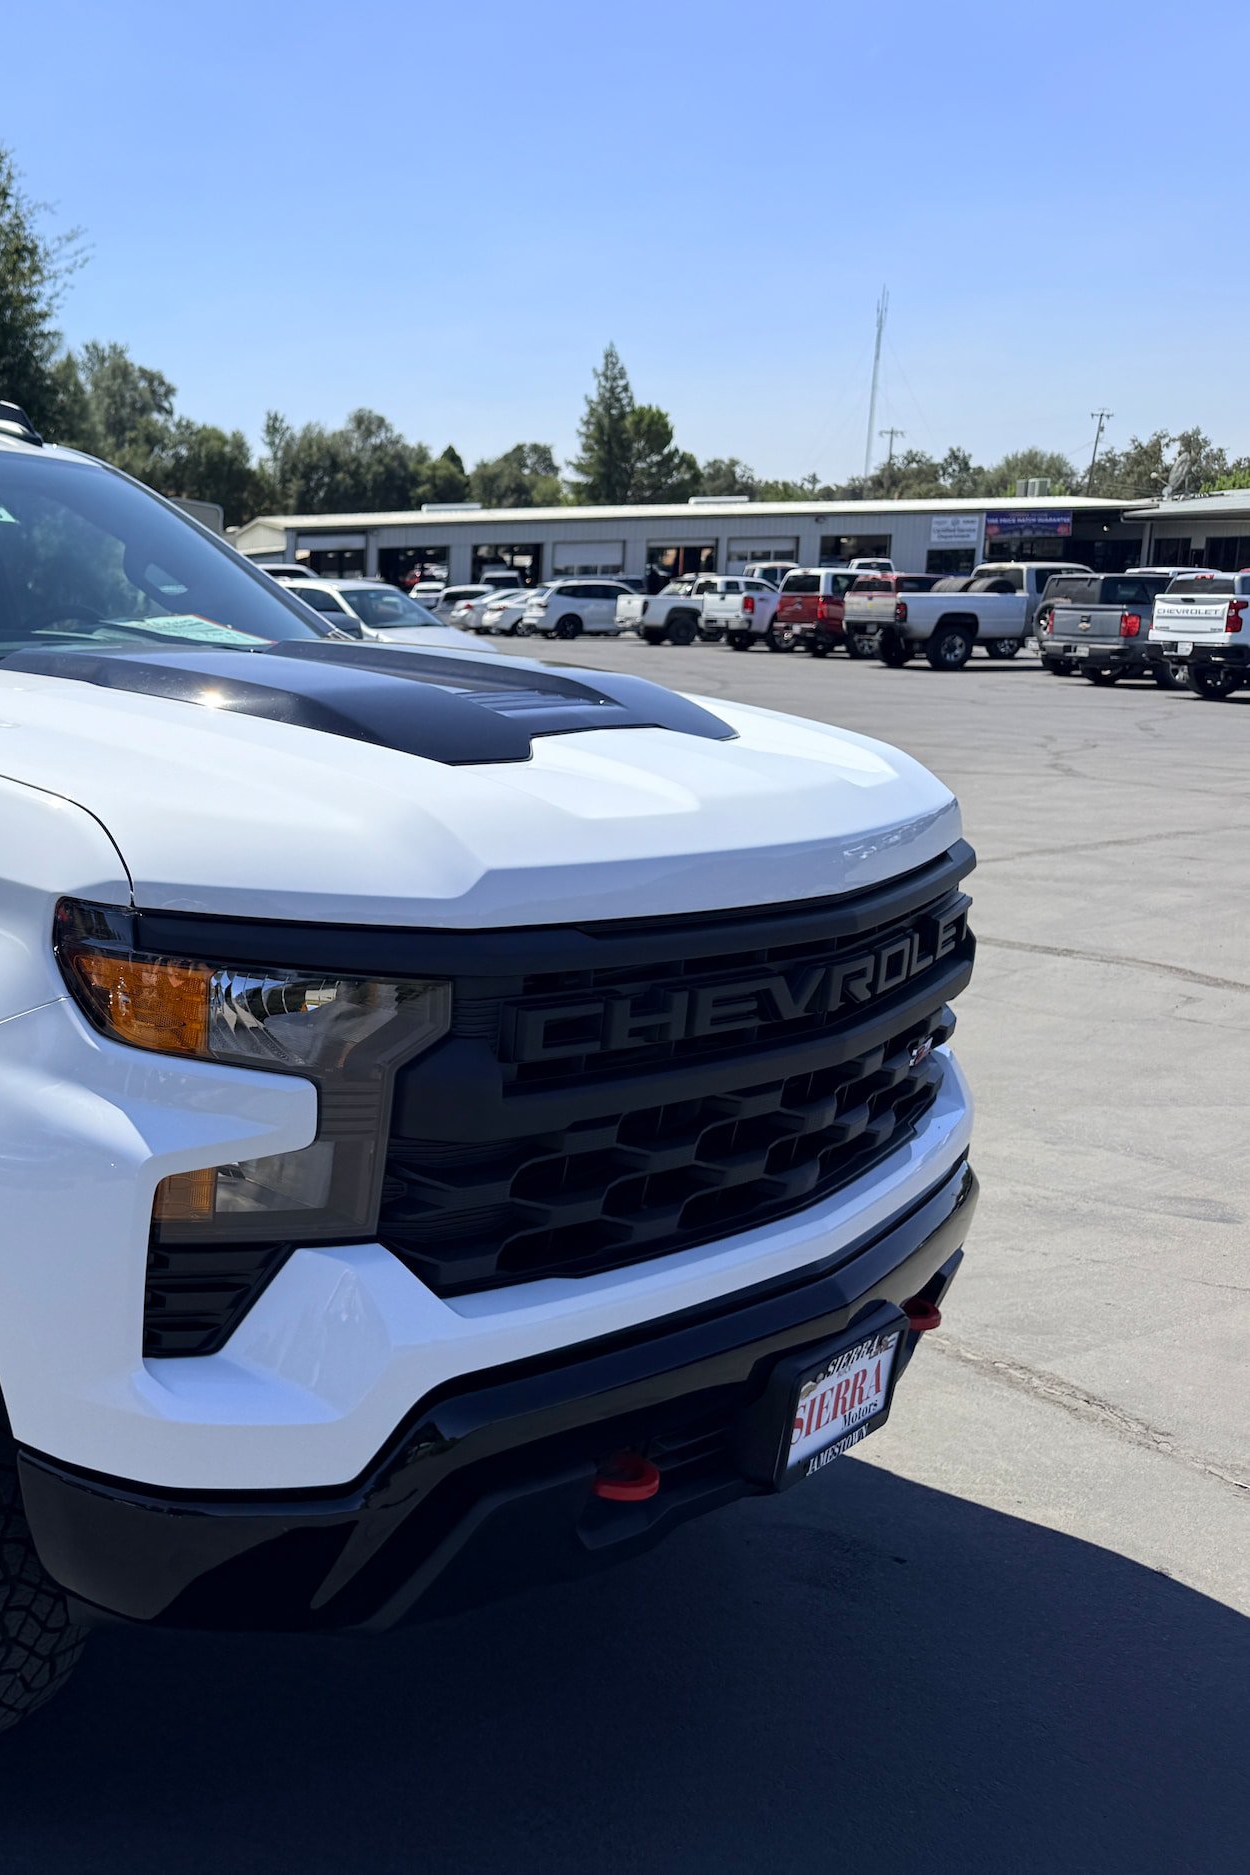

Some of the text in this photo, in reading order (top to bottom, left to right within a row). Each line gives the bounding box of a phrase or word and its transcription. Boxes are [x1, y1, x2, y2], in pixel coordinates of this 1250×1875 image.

[514, 897, 972, 1063] CHEVROLET
[827, 1335, 881, 1376] SIERRA
[790, 1359, 882, 1445] SIERRA
[841, 1399, 878, 1430] Motors
[806, 1422, 870, 1476] JAMESTOWN
